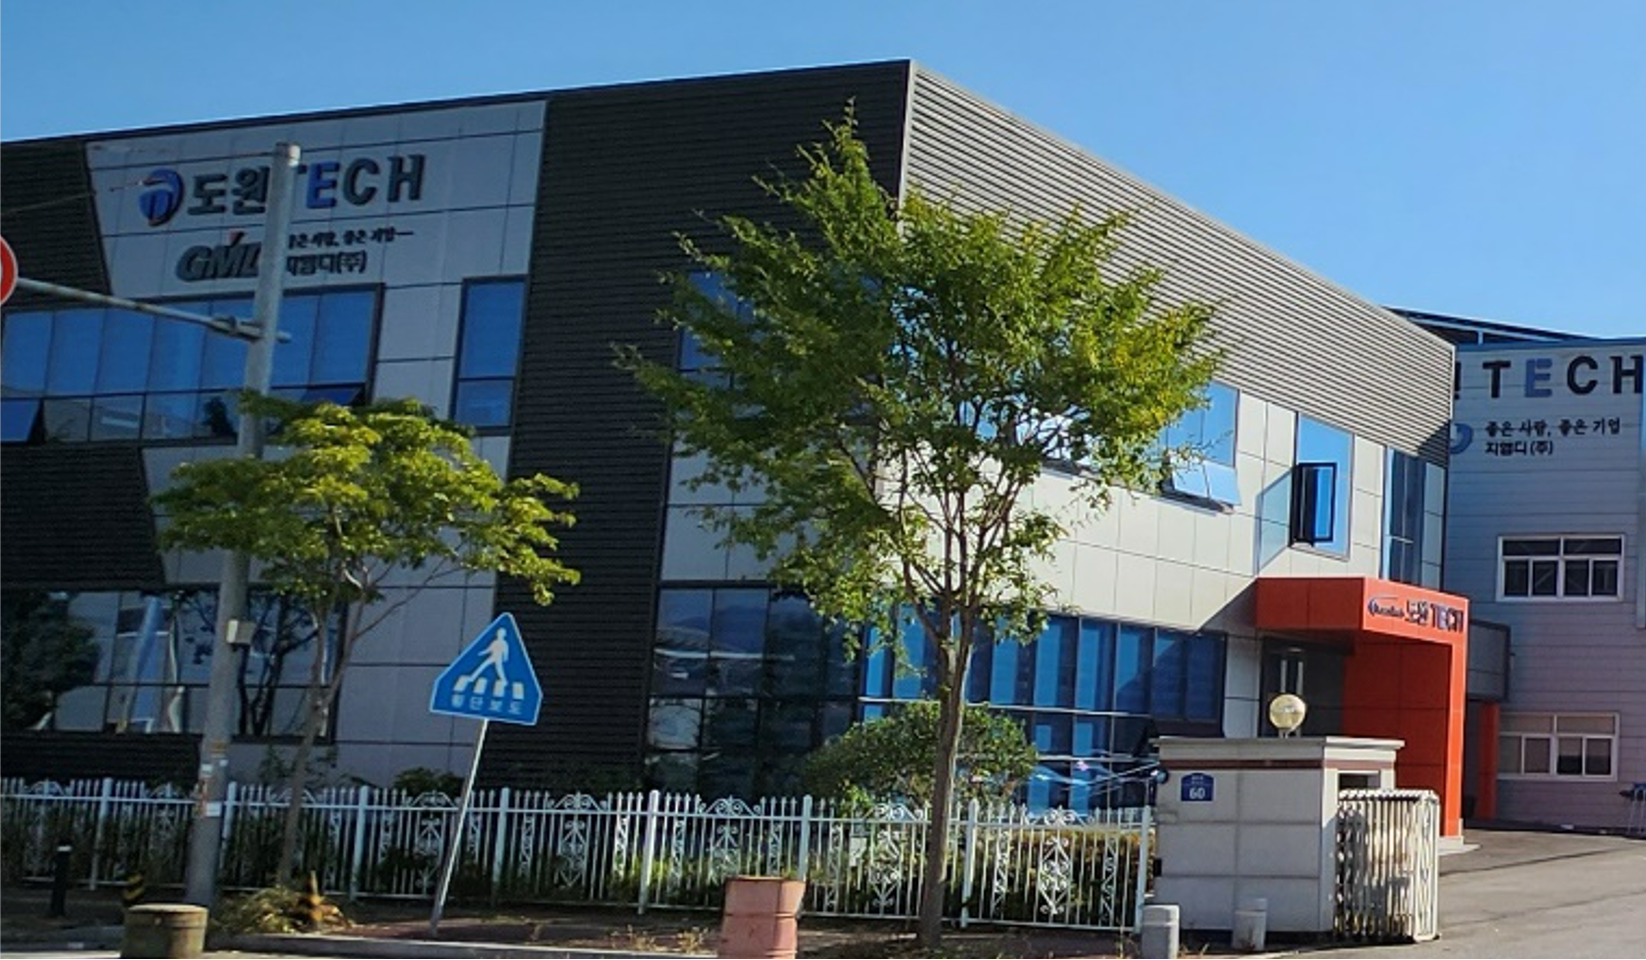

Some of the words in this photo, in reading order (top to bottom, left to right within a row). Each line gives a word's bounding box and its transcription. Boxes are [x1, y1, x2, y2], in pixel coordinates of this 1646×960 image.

[297, 153, 426, 209] ECH
[1482, 355, 1644, 399] TECH
[1485, 421, 1513, 437] 좋은
[1519, 419, 1552, 437] 사람,
[1559, 419, 1587, 437] 좋은
[1593, 417, 1620, 435] 기업
[1189, 787, 1206, 800] 60
